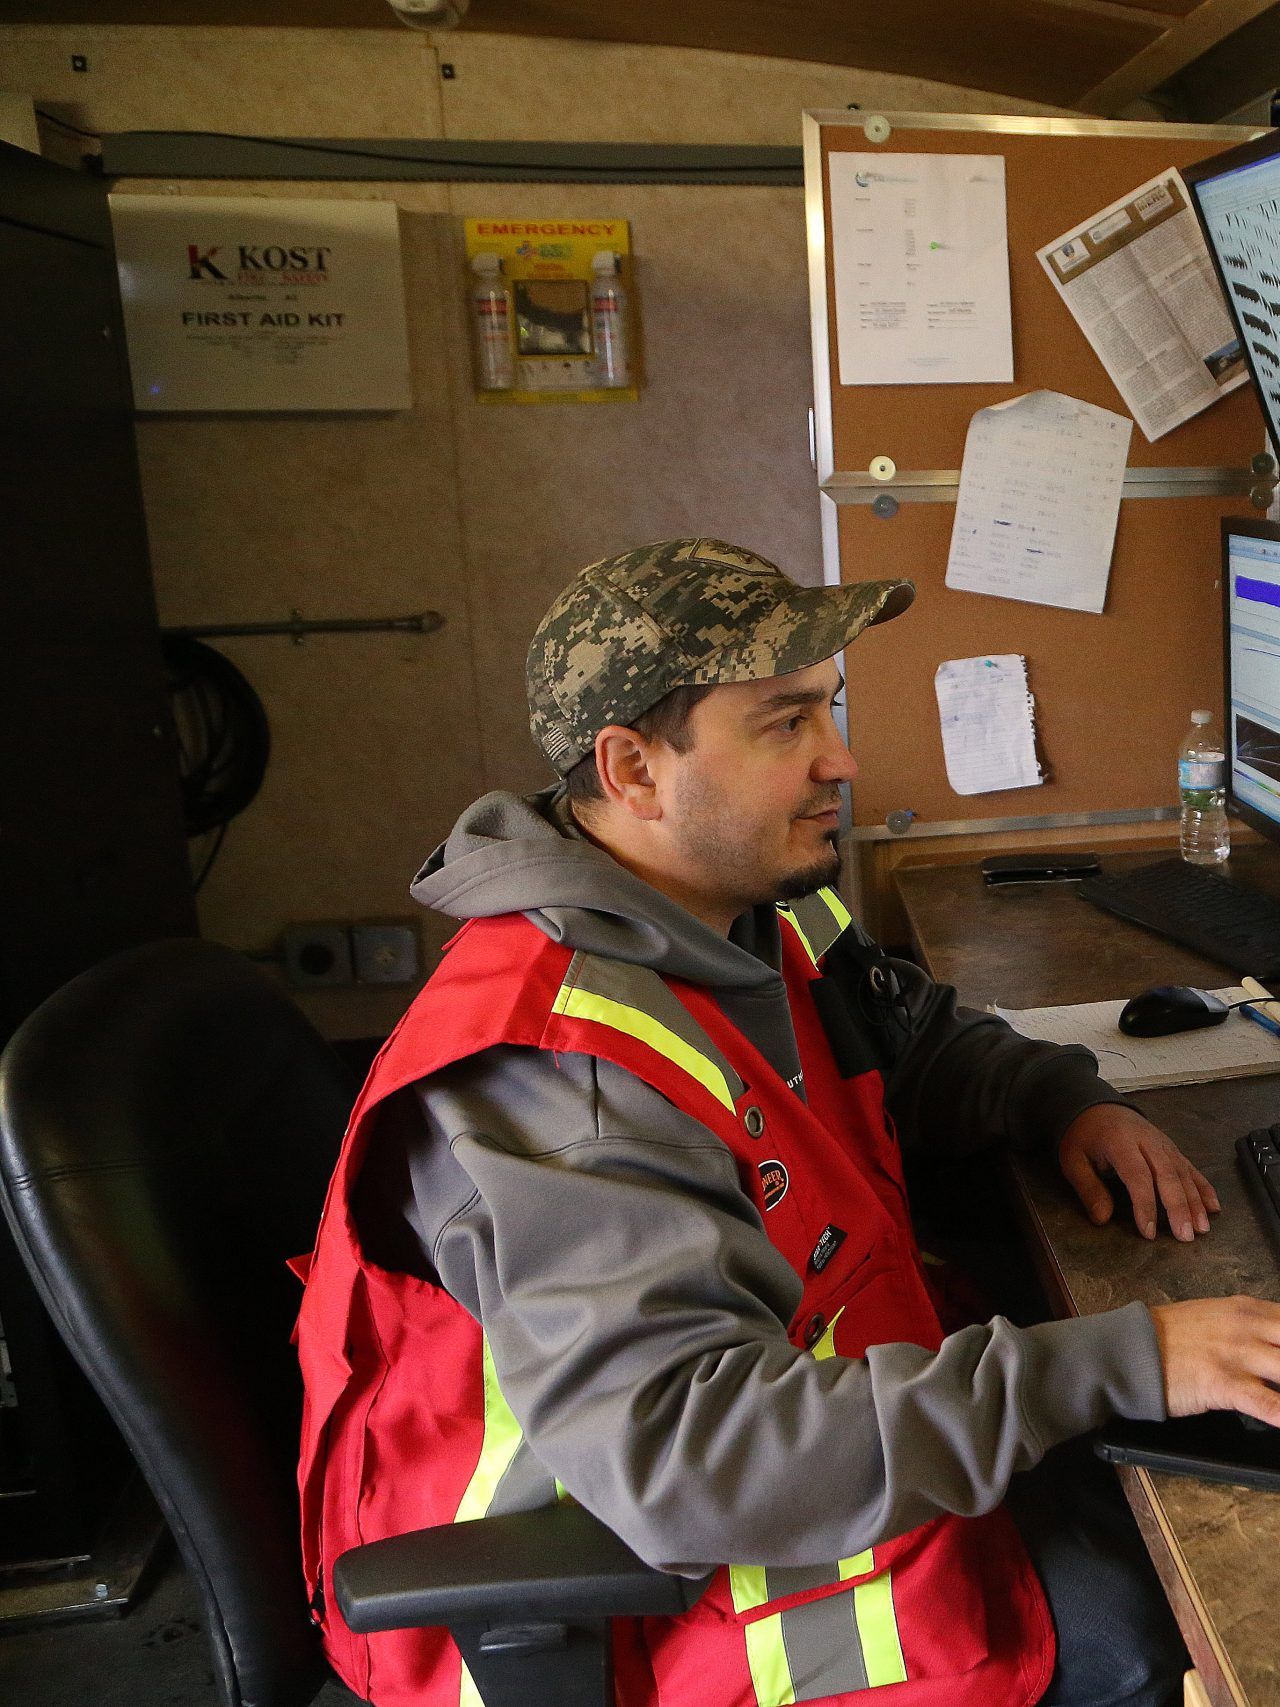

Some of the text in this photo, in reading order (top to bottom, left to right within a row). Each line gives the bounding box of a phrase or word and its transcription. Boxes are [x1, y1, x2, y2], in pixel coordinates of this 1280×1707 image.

[477, 223, 616, 236] EMERGENCY
[238, 245, 332, 272] KOST
[182, 312, 346, 328] FIRST AID KIT
